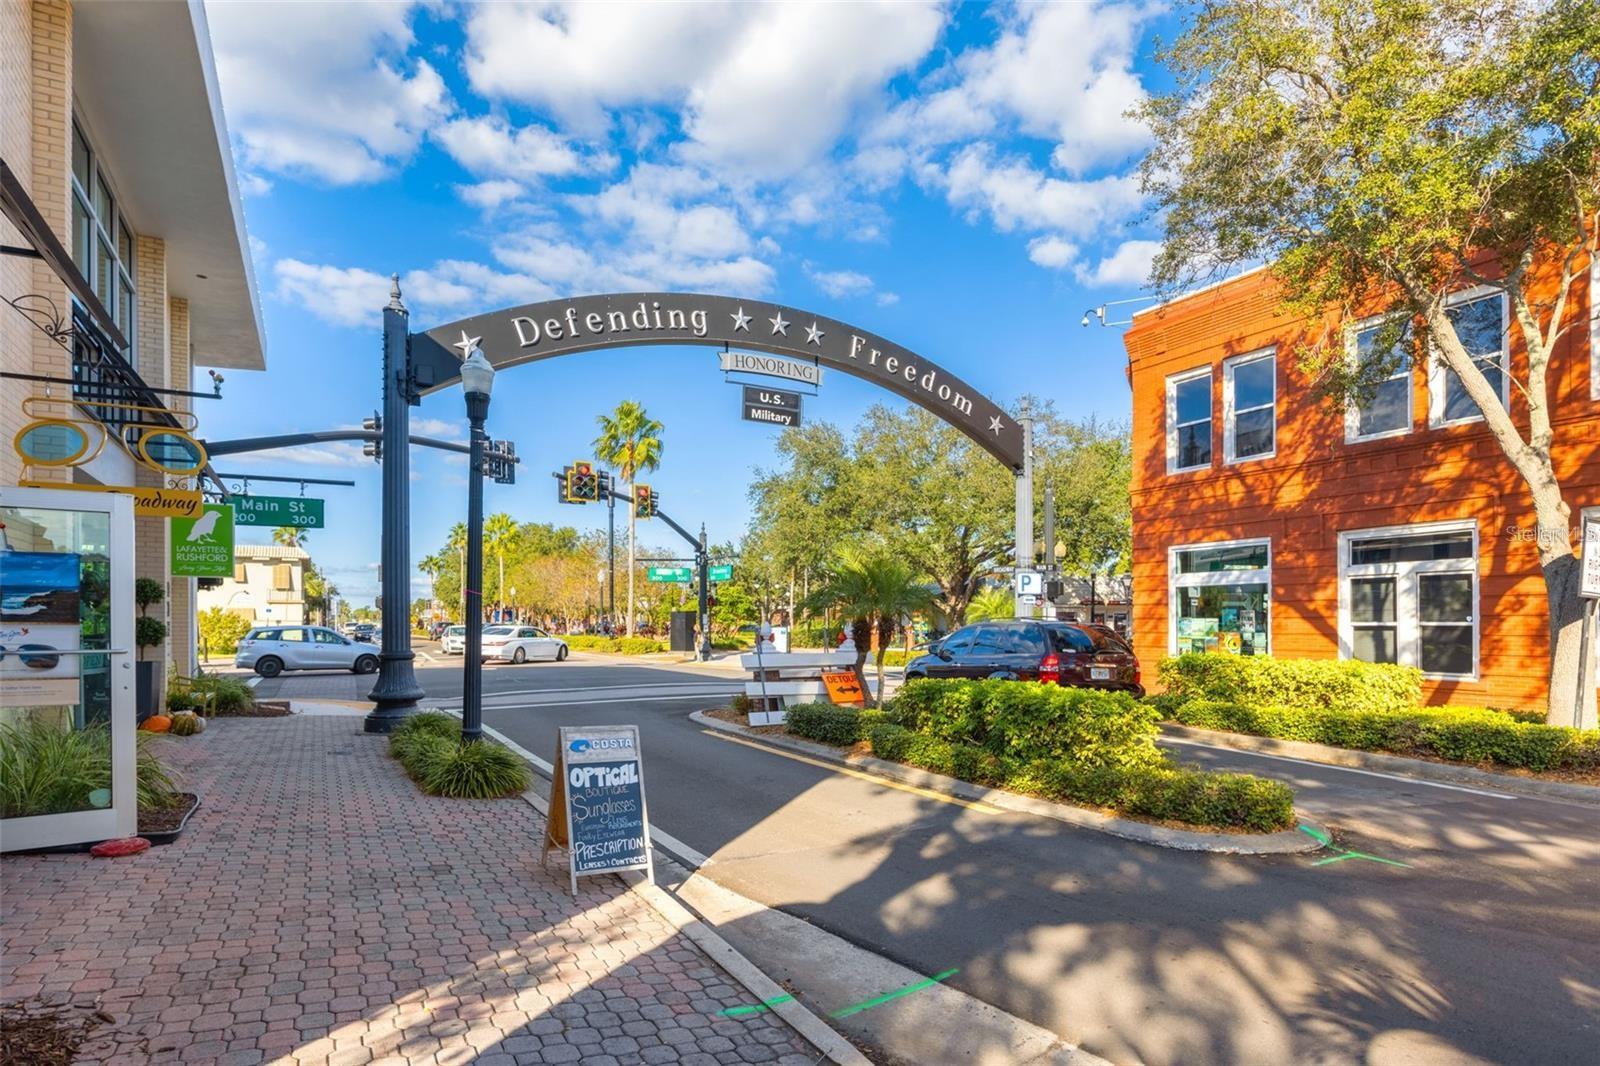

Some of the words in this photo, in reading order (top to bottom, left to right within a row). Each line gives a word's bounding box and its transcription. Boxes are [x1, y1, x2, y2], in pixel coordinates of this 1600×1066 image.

[512, 302, 708, 347] Defending
[849, 334, 974, 416] Freedom
[734, 355, 813, 379] HONORING
[760, 392, 785, 405] U.S.
[751, 408, 791, 425] Military
[134, 491, 198, 516] oadway
[241, 499, 279, 511] Main
[289, 501, 305, 513] St
[292, 515, 316, 524] 300
[176, 553, 228, 562] RUSHFORD
[1021, 575, 1031, 592] P
[592, 739, 633, 749] COSTA
[572, 795, 636, 824] Sunglasses
[575, 837, 643, 862] PRESCRIPTION
[579, 860, 606, 871] LENSES
[611, 855, 647, 867] CONTACTS
